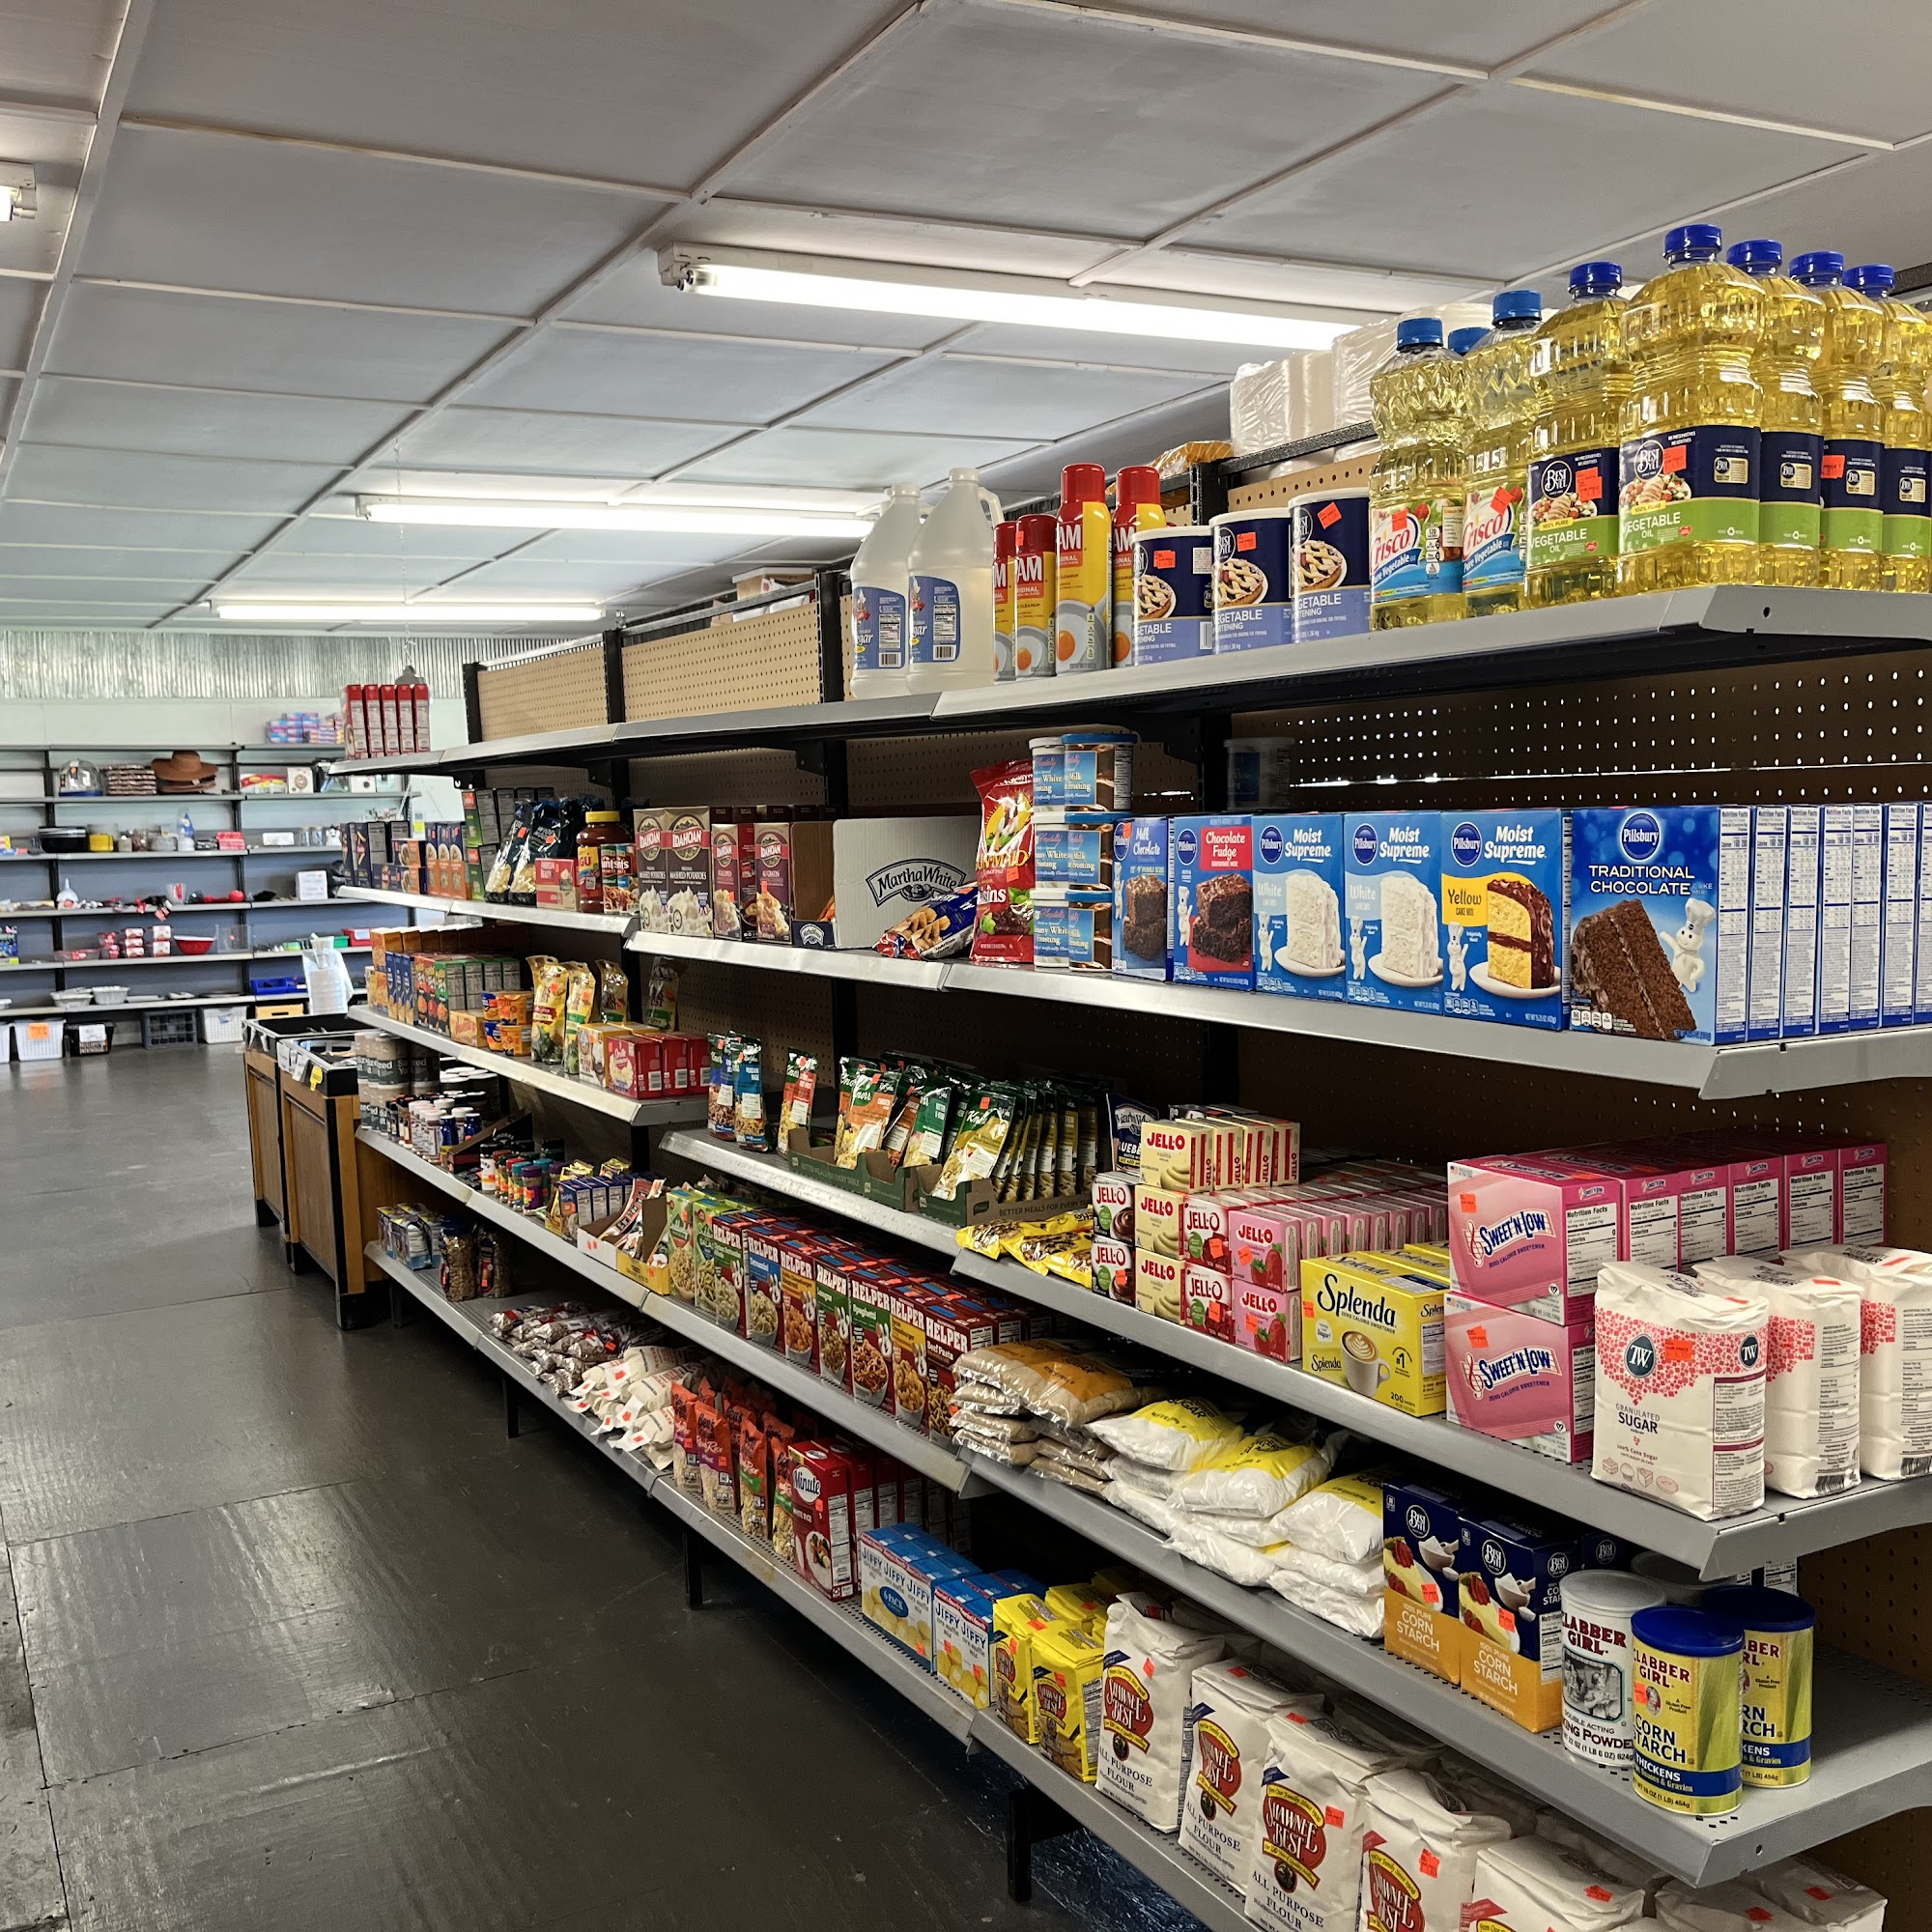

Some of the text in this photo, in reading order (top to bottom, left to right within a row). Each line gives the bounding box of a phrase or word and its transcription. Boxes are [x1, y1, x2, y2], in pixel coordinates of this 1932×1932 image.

[1059, 525, 1082, 551] AM
[1642, 529, 1654, 539] OIL
[1474, 539, 1503, 566] Vegetable
[1549, 544, 1561, 554] OIL
[1016, 554, 1042, 582] AM
[1382, 554, 1410, 577] Vegetable
[639, 830, 661, 849] IDAHOAN
[672, 828, 702, 847] IDAHOAN
[1135, 828, 1150, 841] Milk
[1206, 831, 1246, 845] Chocolate
[1293, 829, 1322, 843] Moist
[1389, 827, 1420, 843] Moist
[1454, 836, 1481, 852] Pillsbury
[1496, 825, 1534, 842] Moist
[1623, 828, 1660, 846] Pillsbury
[760, 843, 781, 858] IDAHOAN
[1046, 850, 1067, 859] White
[1212, 845, 1237, 862] Fudge
[1261, 838, 1282, 853] Pillsbury
[1285, 842, 1331, 863] Supreme
[1354, 837, 1378, 852] Pillsbury
[1379, 842, 1430, 863] Supreme
[1484, 842, 1546, 864] Supreme
[877, 866, 957, 897] Martha White
[1589, 866, 1695, 880] TRADITIONAL
[1257, 882, 1282, 898] White
[1350, 885, 1377, 900] White
[1448, 889, 1482, 905] Yellow
[1590, 881, 1692, 895] CHOCOLATE
[1147, 1131, 1185, 1151] JELL-O
[1790, 1173, 1826, 1184] Nutrition Facts
[1844, 1169, 1864, 1178] Nutrition
[1095, 1185, 1126, 1206] JELL-O
[1681, 1189, 1719, 1202] Nutrition Facts
[1735, 1183, 1757, 1193] Nutrition
[1000, 1208, 1024, 1216] BETTER
[1025, 1205, 1045, 1214] MEALS
[1060, 1202, 1082, 1211] EVERY
[1141, 1196, 1174, 1216] JELL-O
[1593, 1206, 1607, 1214] Facts
[1631, 1198, 1669, 1210] Nutrition Facts
[1186, 1211, 1220, 1232] JELL-O
[713, 1223, 742, 1250] HELPER
[1238, 1225, 1273, 1244] JELL-O
[1480, 1211, 1546, 1256] SWEET'N LOW
[748, 1236, 779, 1264] HELPER
[1094, 1245, 1126, 1266] JELL-O
[780, 1250, 812, 1280] HELPER
[1141, 1259, 1176, 1280] JELL-O
[816, 1264, 847, 1295] HELPER
[1189, 1276, 1223, 1298] JELL-O
[852, 1280, 891, 1312] HELPER
[1241, 1292, 1277, 1313] JELL-O
[1317, 1274, 1396, 1327] Splenda
[890, 1295, 924, 1330] HELPER
[1420, 1303, 1444, 1318] Splen
[925, 1317, 968, 1353] HELPER
[926, 1340, 954, 1361] Beef Pasta
[1396, 1352, 1406, 1369] #1
[1629, 1346, 1652, 1367] TW
[1742, 1345, 1756, 1360] TW
[1311, 1354, 1342, 1372] Splenda
[1480, 1348, 1549, 1390] SWEET'N LOW
[1391, 1391, 1404, 1403] 200
[1616, 1403, 1661, 1422] GRANULATED
[1618, 1412, 1658, 1435] SUGAR
[1642, 1450, 1658, 1461] Sugar
[794, 1470, 821, 1495] Minute
[862, 1547, 930, 1605] JIFFY JIFFY JIFFY
[883, 1590, 904, 1610] 6-PACK
[935, 1602, 986, 1649] JIFFY JIFFY
[1402, 1610, 1434, 1635] CORN
[1416, 1609, 1432, 1621] PURE
[1397, 1621, 1440, 1653] STARCH
[1568, 1631, 1604, 1656] GIRL
[1479, 1650, 1511, 1677] CORN
[1493, 1648, 1510, 1662] PURE
[1473, 1660, 1518, 1695] STARCH
[1639, 1665, 1670, 1689] GIRL
[1106, 1678, 1147, 1722] SHAWNEE
[1113, 1699, 1134, 1730] BEST
[1586, 1721, 1615, 1735] ACTING
[1635, 1714, 1676, 1746] CORN
[1582, 1729, 1634, 1749] POWDE
[1588, 1746, 1615, 1761] LB OZ)
[1111, 1756, 1153, 1787] PURPOSE
[1636, 1753, 1681, 1782] THICKENS
[1107, 1767, 1135, 1793] FLOUR
[1186, 1802, 1241, 1852] ALL PURPOSE
[1265, 1797, 1318, 1854] SHAWNEE
[1193, 1825, 1222, 1855] FLOUR
[1273, 1823, 1303, 1860] BEST
[1252, 1869, 1323, 1928] ALL PURPOSE
[1266, 1896, 1303, 1931] FLOUR
